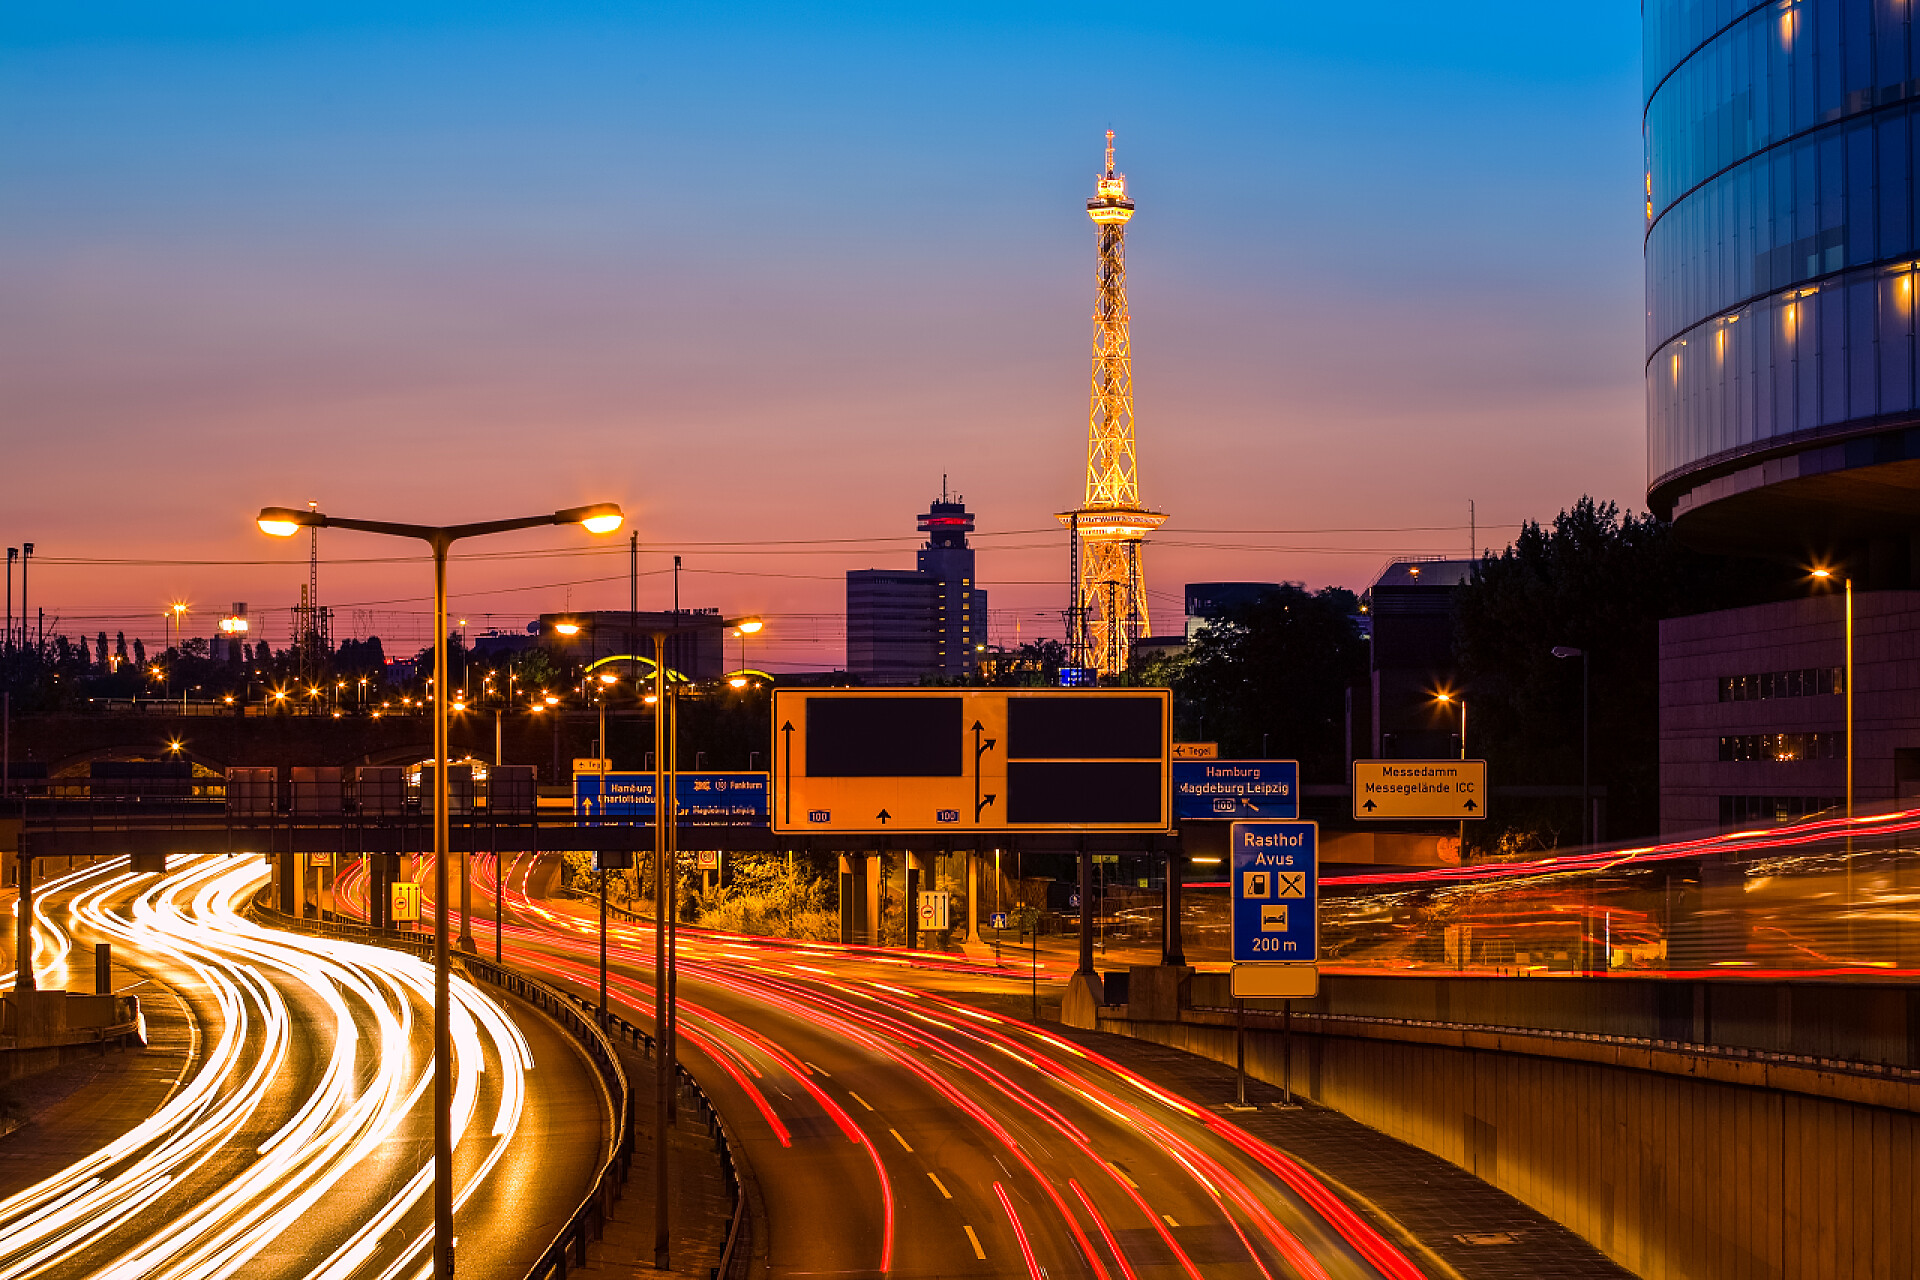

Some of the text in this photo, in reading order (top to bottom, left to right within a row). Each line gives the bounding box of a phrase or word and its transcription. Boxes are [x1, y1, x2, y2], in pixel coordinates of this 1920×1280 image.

[1188, 746, 1211, 756] Tegel
[589, 761, 607, 770] Tegl
[1206, 766, 1261, 780] Hamburg
[1382, 766, 1458, 777] Messedamm
[611, 783, 653, 795] Hamburg
[730, 781, 763, 790] Funkturm
[1179, 782, 1289, 796] Magdeburg Leipzig
[1365, 782, 1475, 796] Messegelände ICC
[1217, 800, 1232, 811] 100
[812, 812, 828, 822] 100
[940, 811, 956, 821] 100
[1244, 832, 1305, 847] Rasthof
[1255, 851, 1294, 866] Avus
[1252, 937, 1297, 952] 200 m
